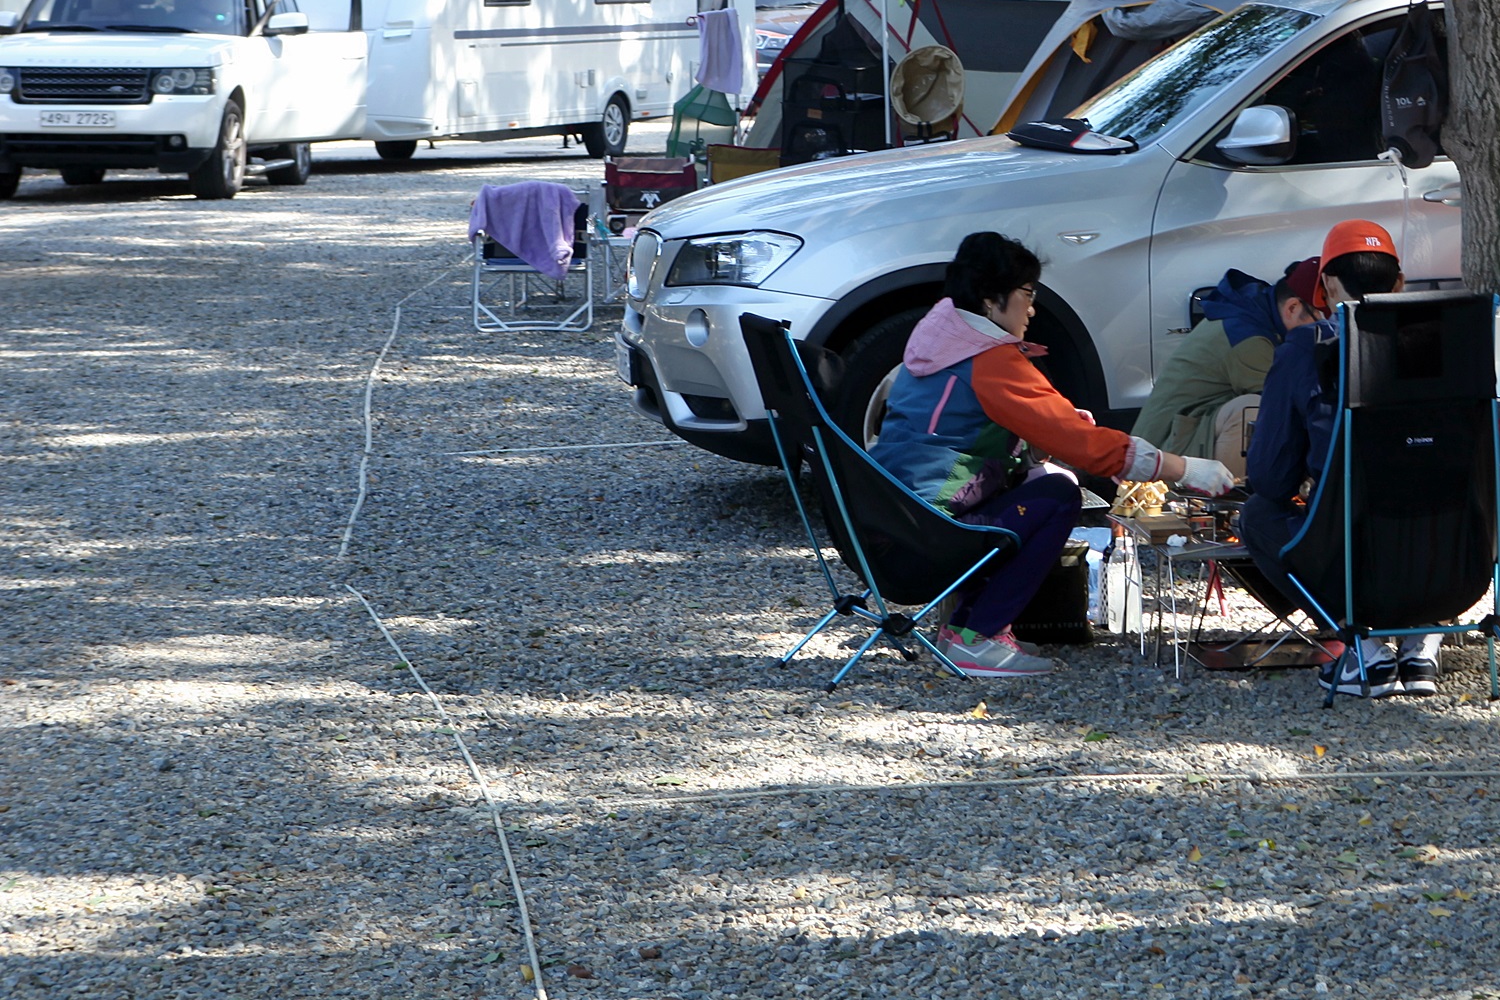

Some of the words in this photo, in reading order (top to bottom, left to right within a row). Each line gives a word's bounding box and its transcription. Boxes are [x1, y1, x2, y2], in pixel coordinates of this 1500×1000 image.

[1395, 97, 1413, 106] 10L
[77, 113, 109, 125] 2725
[1365, 236, 1382, 247] NFL
